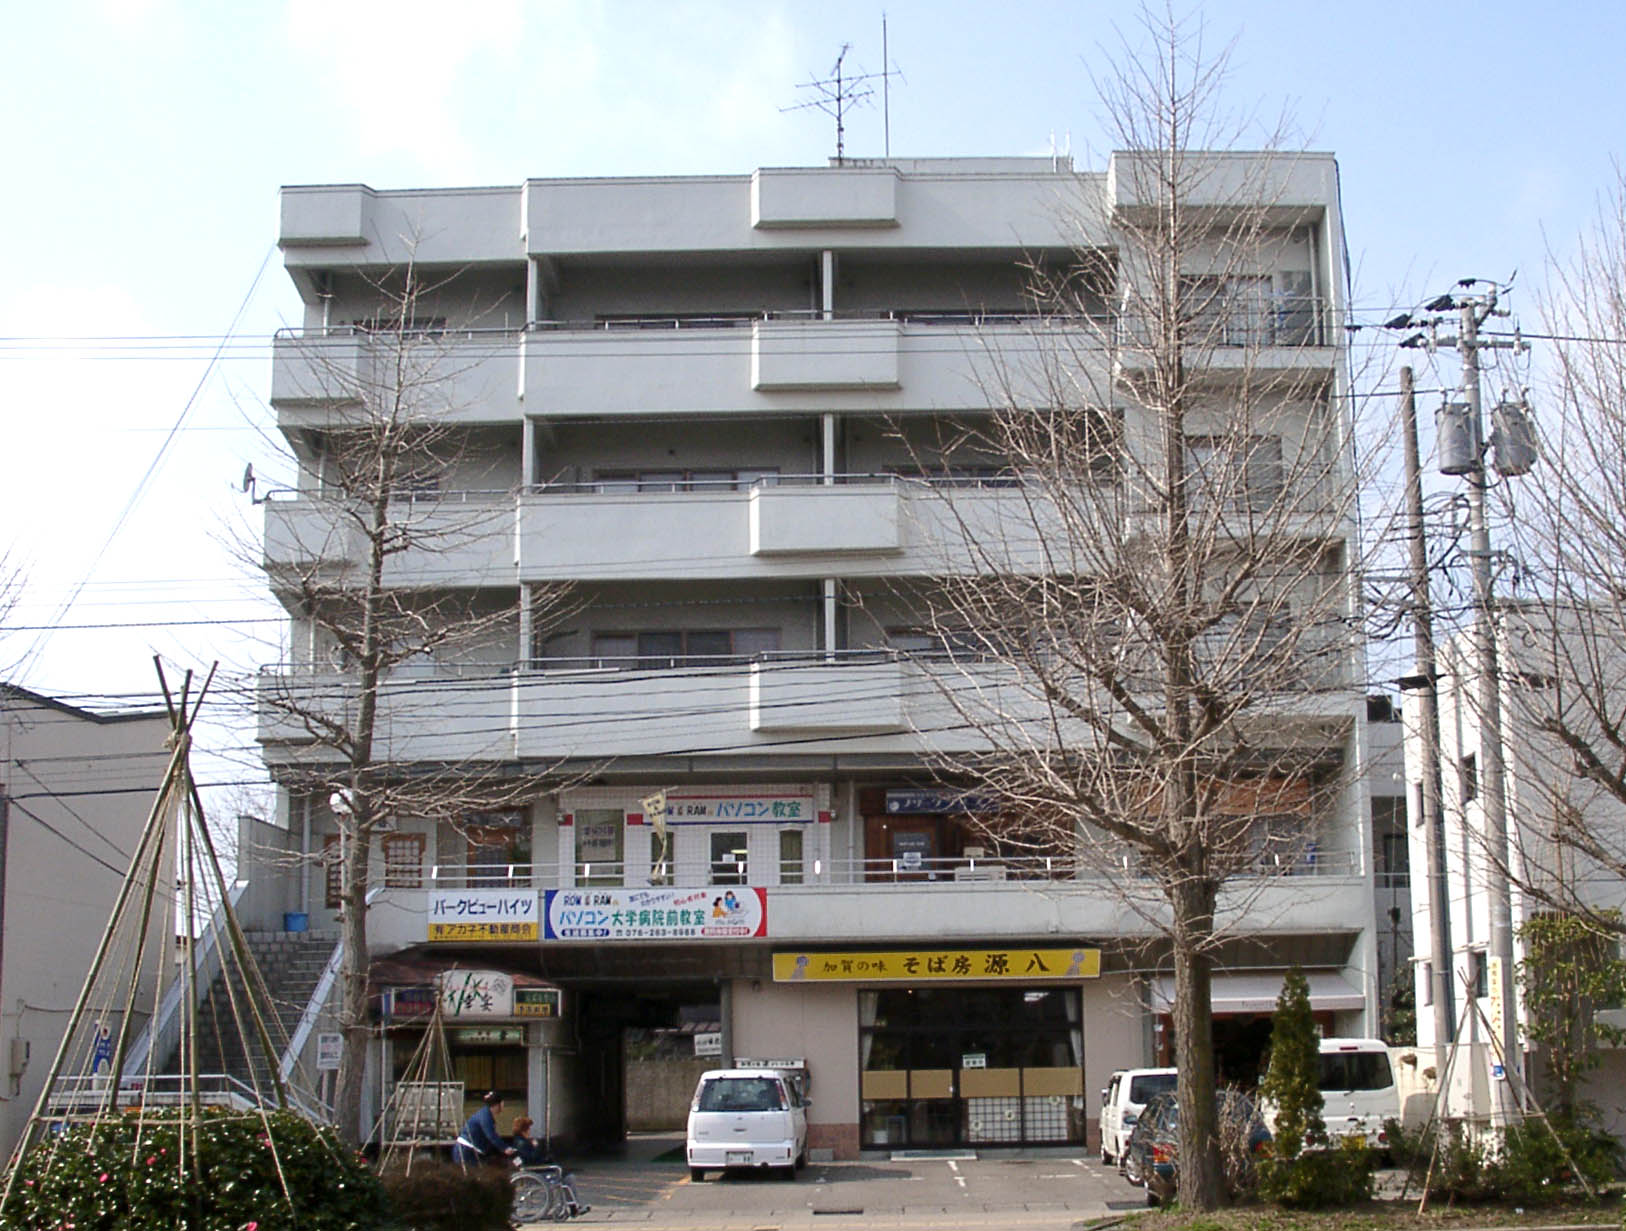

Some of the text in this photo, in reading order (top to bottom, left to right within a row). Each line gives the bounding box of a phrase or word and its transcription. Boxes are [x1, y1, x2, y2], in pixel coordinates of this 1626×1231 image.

[717, 801, 801, 817] パソコン教室
[559, 910, 705, 926] パソコン大学病院前教室
[823, 953, 1050, 975] 加賀の味 そば房源八
